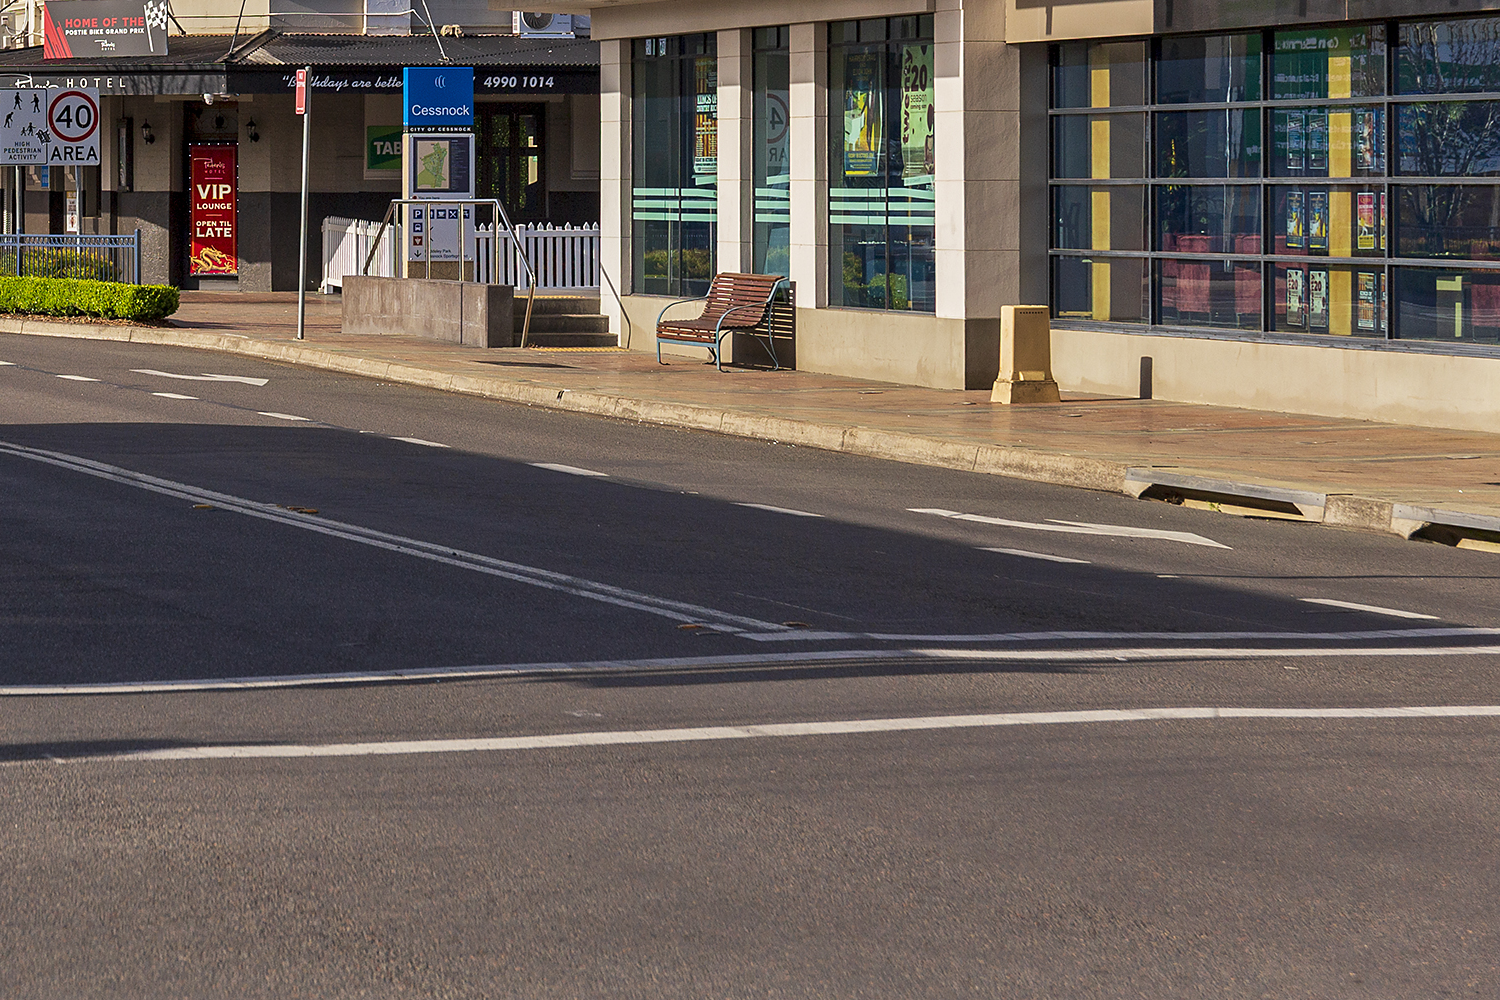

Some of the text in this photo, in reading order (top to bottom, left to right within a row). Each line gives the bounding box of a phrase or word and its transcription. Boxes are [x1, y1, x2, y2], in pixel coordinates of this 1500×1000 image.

[65, 16, 144, 28] HOME OF THE
[66, 78, 126, 88] HOTEL
[484, 76, 518, 88] 4990
[522, 76, 554, 88] 1014
[910, 64, 928, 92] 20
[56, 104, 92, 129] 40
[412, 104, 470, 116] Cessnock
[50, 146, 98, 161] AREA
[373, 141, 402, 155] TAB
[196, 184, 232, 200] VIP
[196, 228, 232, 238] LATE
